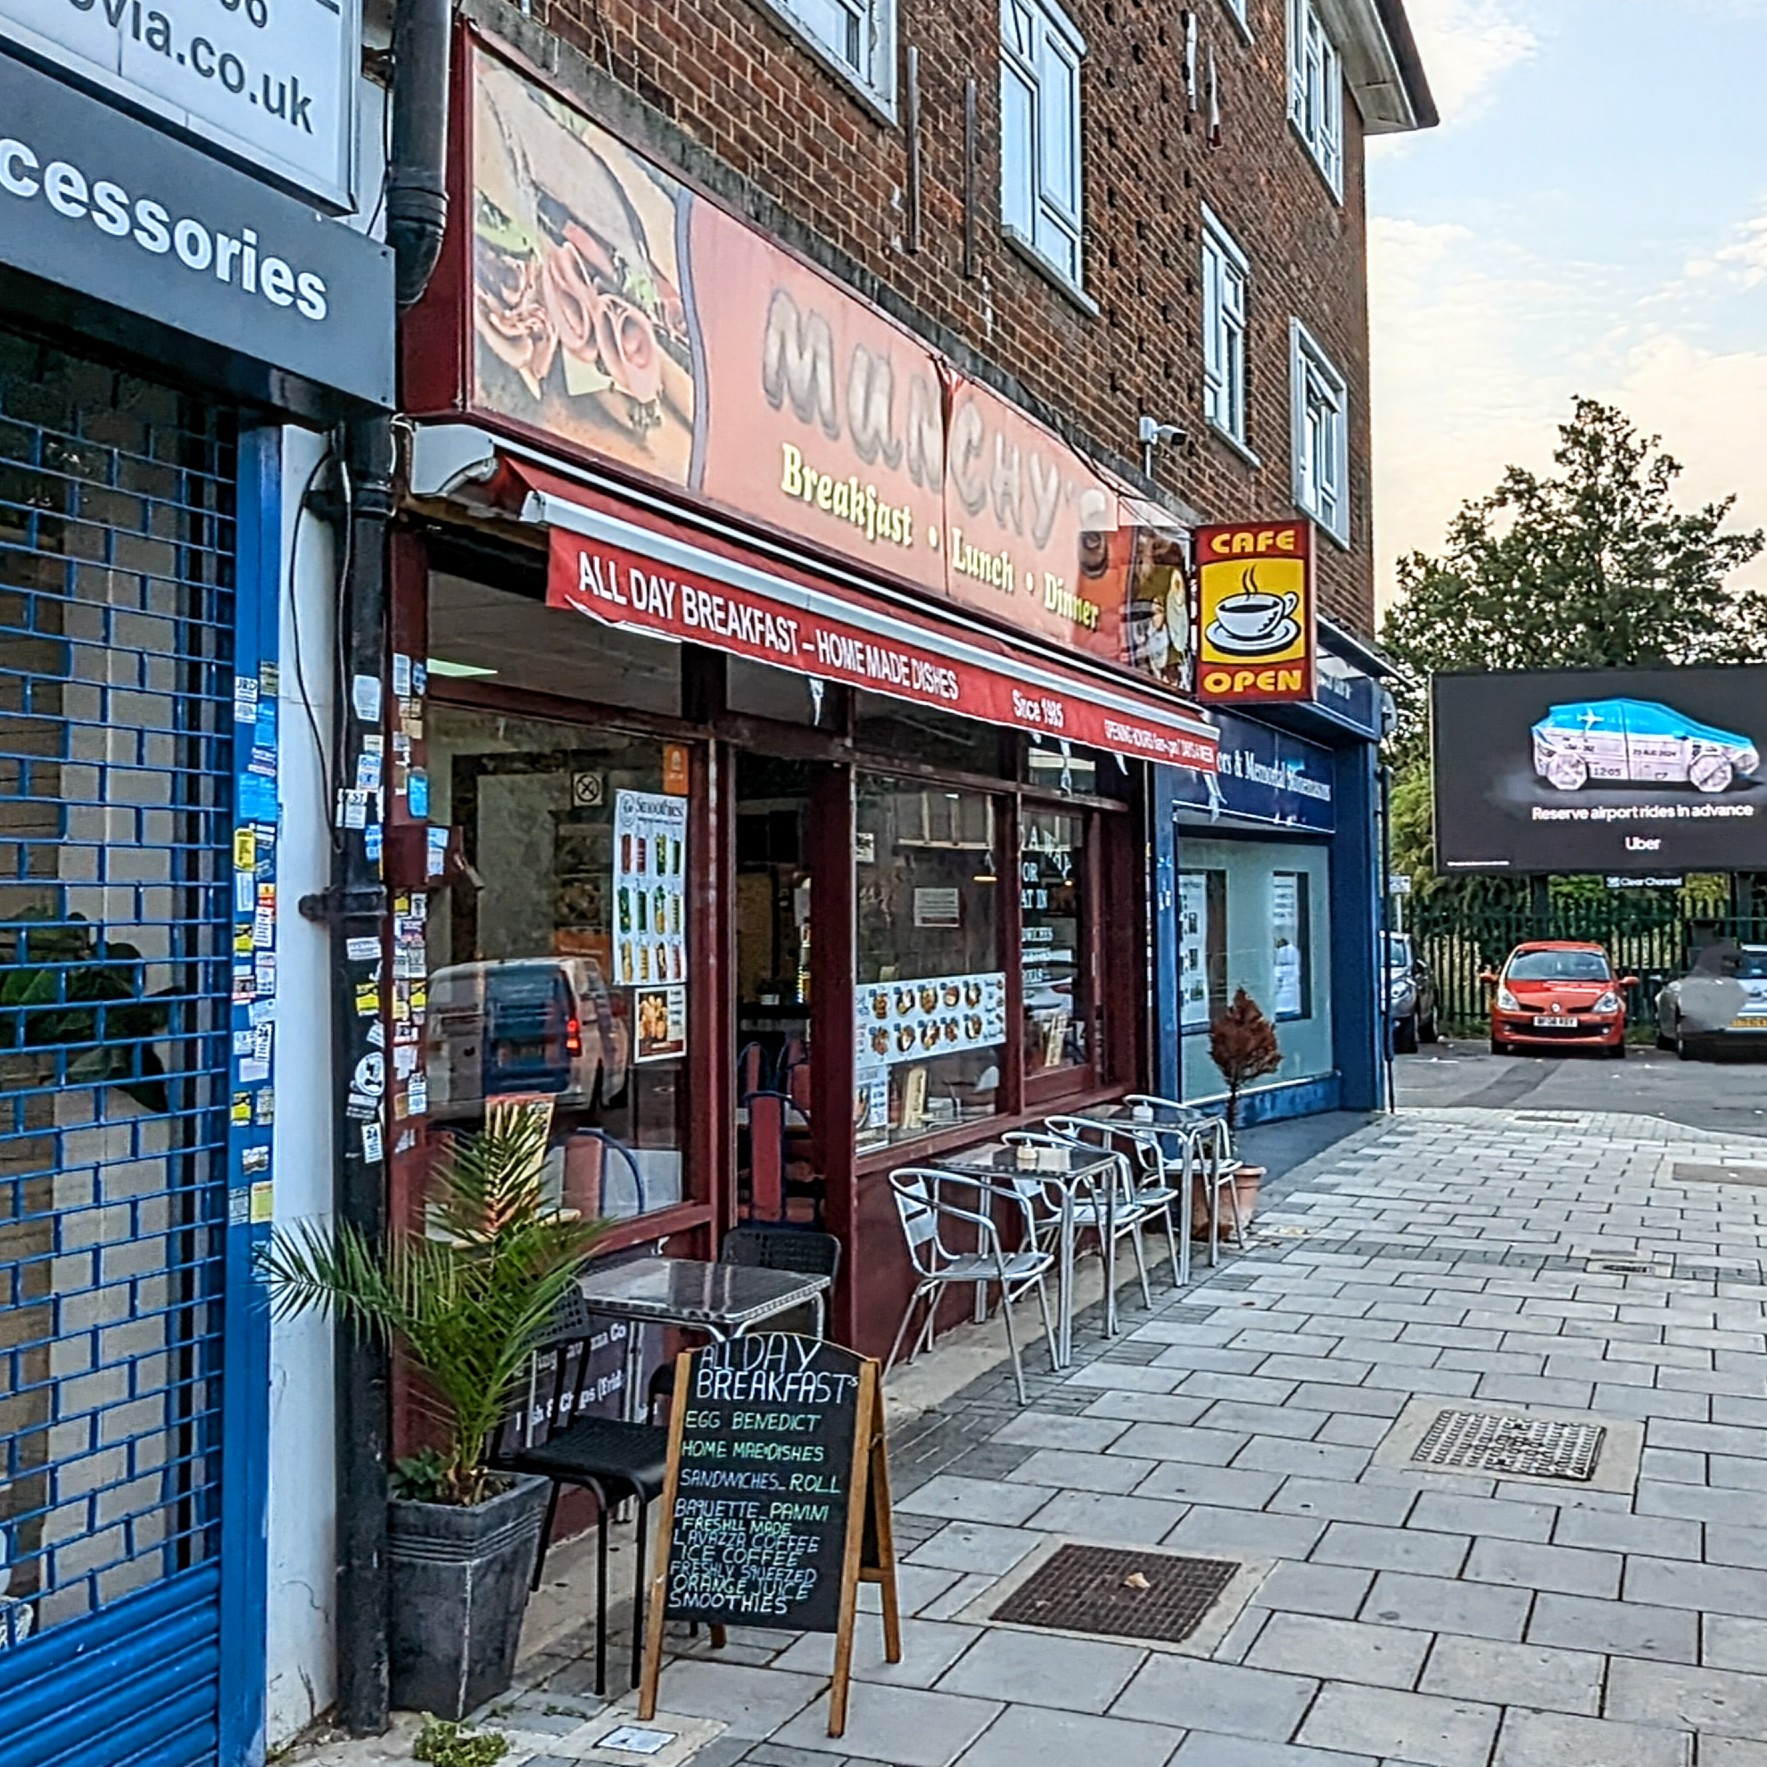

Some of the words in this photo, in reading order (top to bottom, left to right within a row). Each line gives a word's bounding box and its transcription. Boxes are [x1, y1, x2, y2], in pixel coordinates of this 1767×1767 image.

[68, 0, 313, 135] via.co.uk
[0, 137, 328, 321] cessories
[781, 442, 914, 547] Breakfast
[951, 526, 1014, 592] Lunch
[1044, 571, 1100, 632] Dinner
[1210, 530, 1296, 554] CAFE
[578, 550, 628, 607] ALL
[629, 568, 677, 620] DAY
[681, 584, 799, 657] BREAKFAST
[1203, 669, 1303, 693] OPEN
[1012, 689, 1041, 722] Since
[1532, 807, 1589, 820] Reserve
[1590, 806, 1639, 822] airport
[1640, 805, 1676, 819] rides
[1677, 804, 1690, 817] in
[1691, 804, 1754, 817] advance
[1625, 836, 1661, 850] Uber
[1022, 862, 1039, 882] OR
[1620, 877, 1644, 887] Clear
[1644, 876, 1682, 887] Channel
[700, 1340, 735, 1371] ALL
[743, 1332, 822, 1373] DAY
[685, 1410, 721, 1429] EGG
[732, 1411, 822, 1432] BENEDICT
[681, 1440, 728, 1458] HOME
[789, 1473, 842, 1494] ROLL
[770, 1501, 830, 1522] PANINI
[750, 1520, 793, 1536] MADE
[673, 1529, 747, 1547] LAVAZZA
[752, 1533, 821, 1553] COFFEE
[681, 1543, 716, 1562] ICE
[722, 1546, 802, 1567] COFFEE
[670, 1560, 736, 1578] FRESHLY
[673, 1573, 747, 1594] ORANGE
[751, 1577, 814, 1601] JUICE
[668, 1589, 787, 1615] SMOOTHIES
